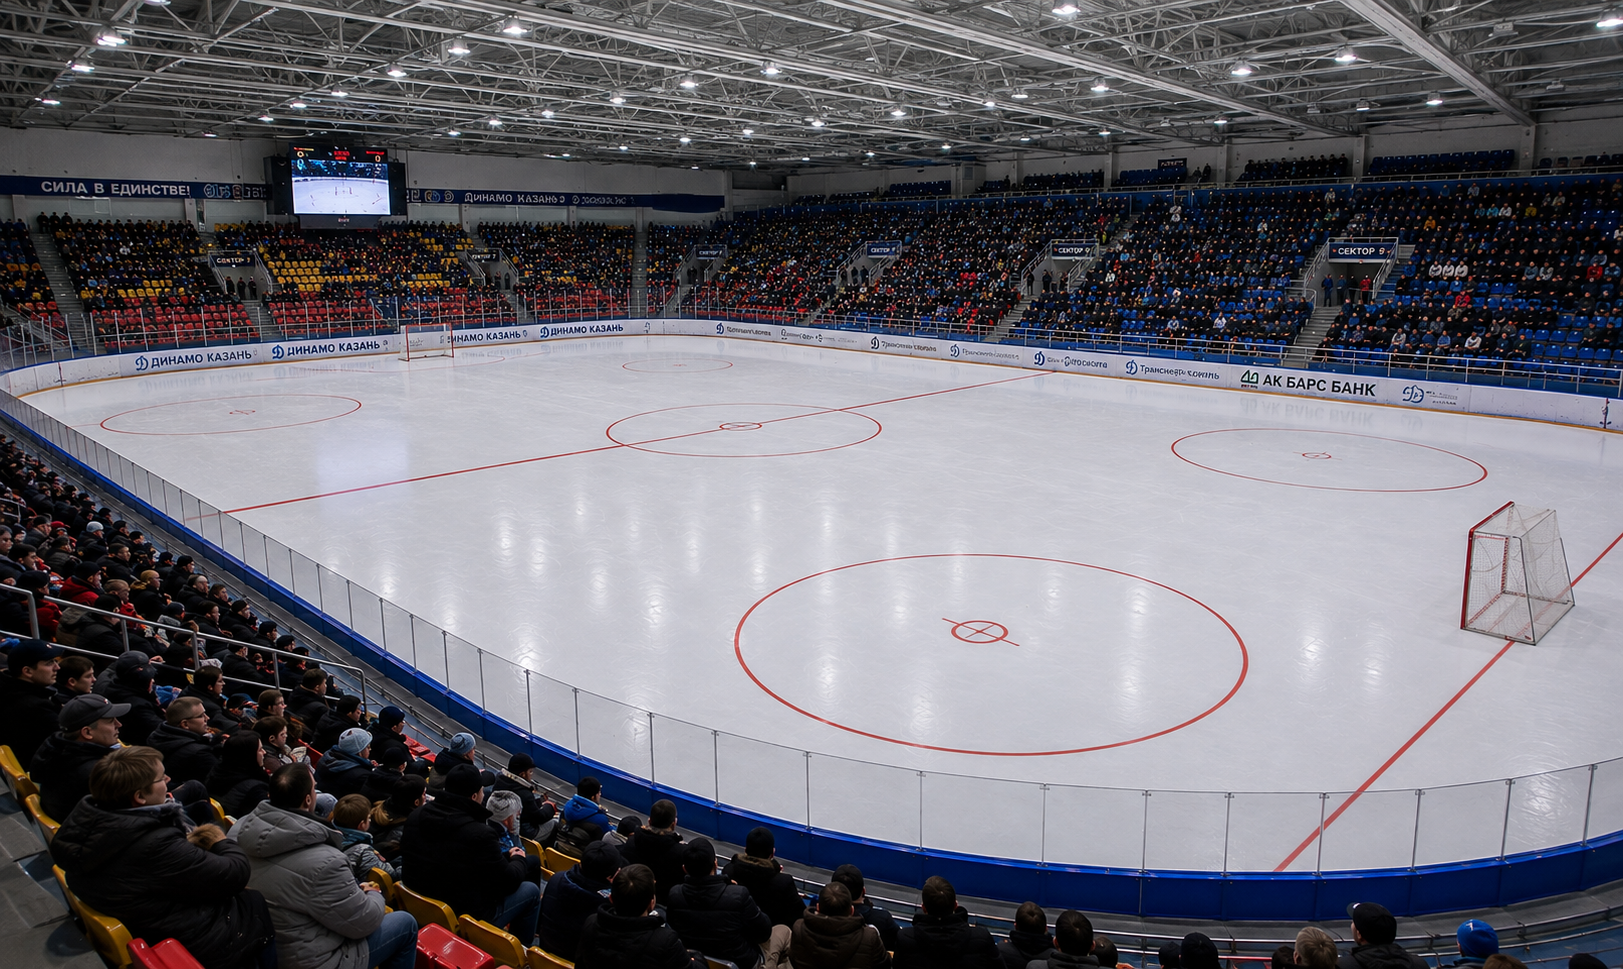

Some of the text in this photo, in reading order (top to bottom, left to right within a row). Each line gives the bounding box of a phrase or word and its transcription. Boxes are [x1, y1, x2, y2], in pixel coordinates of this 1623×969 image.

[41, 181, 88, 194] СИЛА
[94, 183, 105, 194] В
[111, 183, 191, 196] ЕДИНСТВЕ!
[1338, 247, 1376, 256] СЕКТОР
[486, 330, 521, 342] КАЗАНЬ
[550, 323, 624, 337] ДИНАМО КАЗАНЬ
[338, 340, 381, 352] КАЗАНЬ
[151, 350, 252, 369] ДИНАМО КАЗАНЬ
[1263, 374, 1376, 397] АК БАРС БАНК
